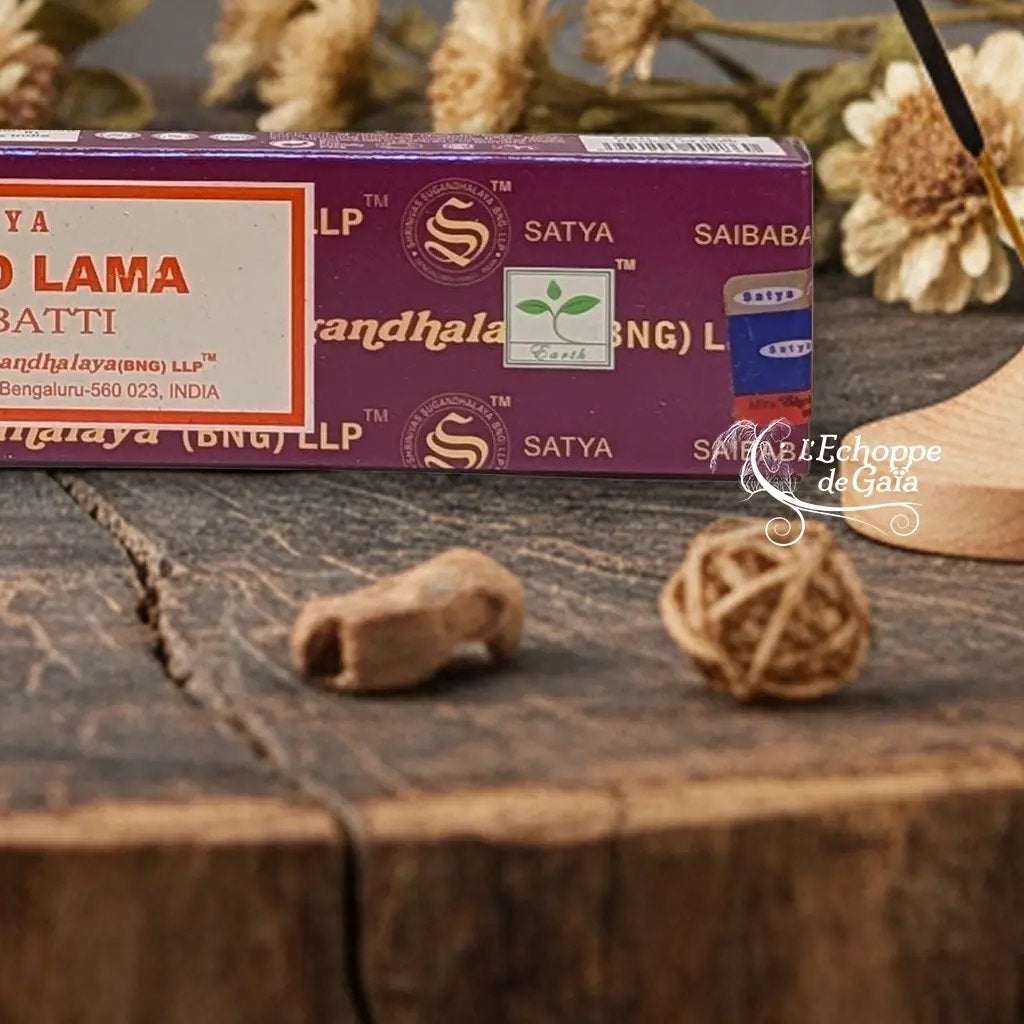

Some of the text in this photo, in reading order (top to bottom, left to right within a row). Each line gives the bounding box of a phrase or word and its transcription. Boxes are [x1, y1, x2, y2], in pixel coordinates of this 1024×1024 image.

[314, 207, 364, 237] LP
[524, 220, 615, 243] SATYA
[694, 222, 812, 247] SAIBABA
[33, 254, 190, 295] LAMA
[742, 289, 795, 303] Satya
[529, 343, 589, 362] Earth
[126, 383, 164, 400] 023,
[169, 383, 220, 400] INDIA
[298, 421, 364, 451] LLP
[523, 435, 614, 458] SATYA
